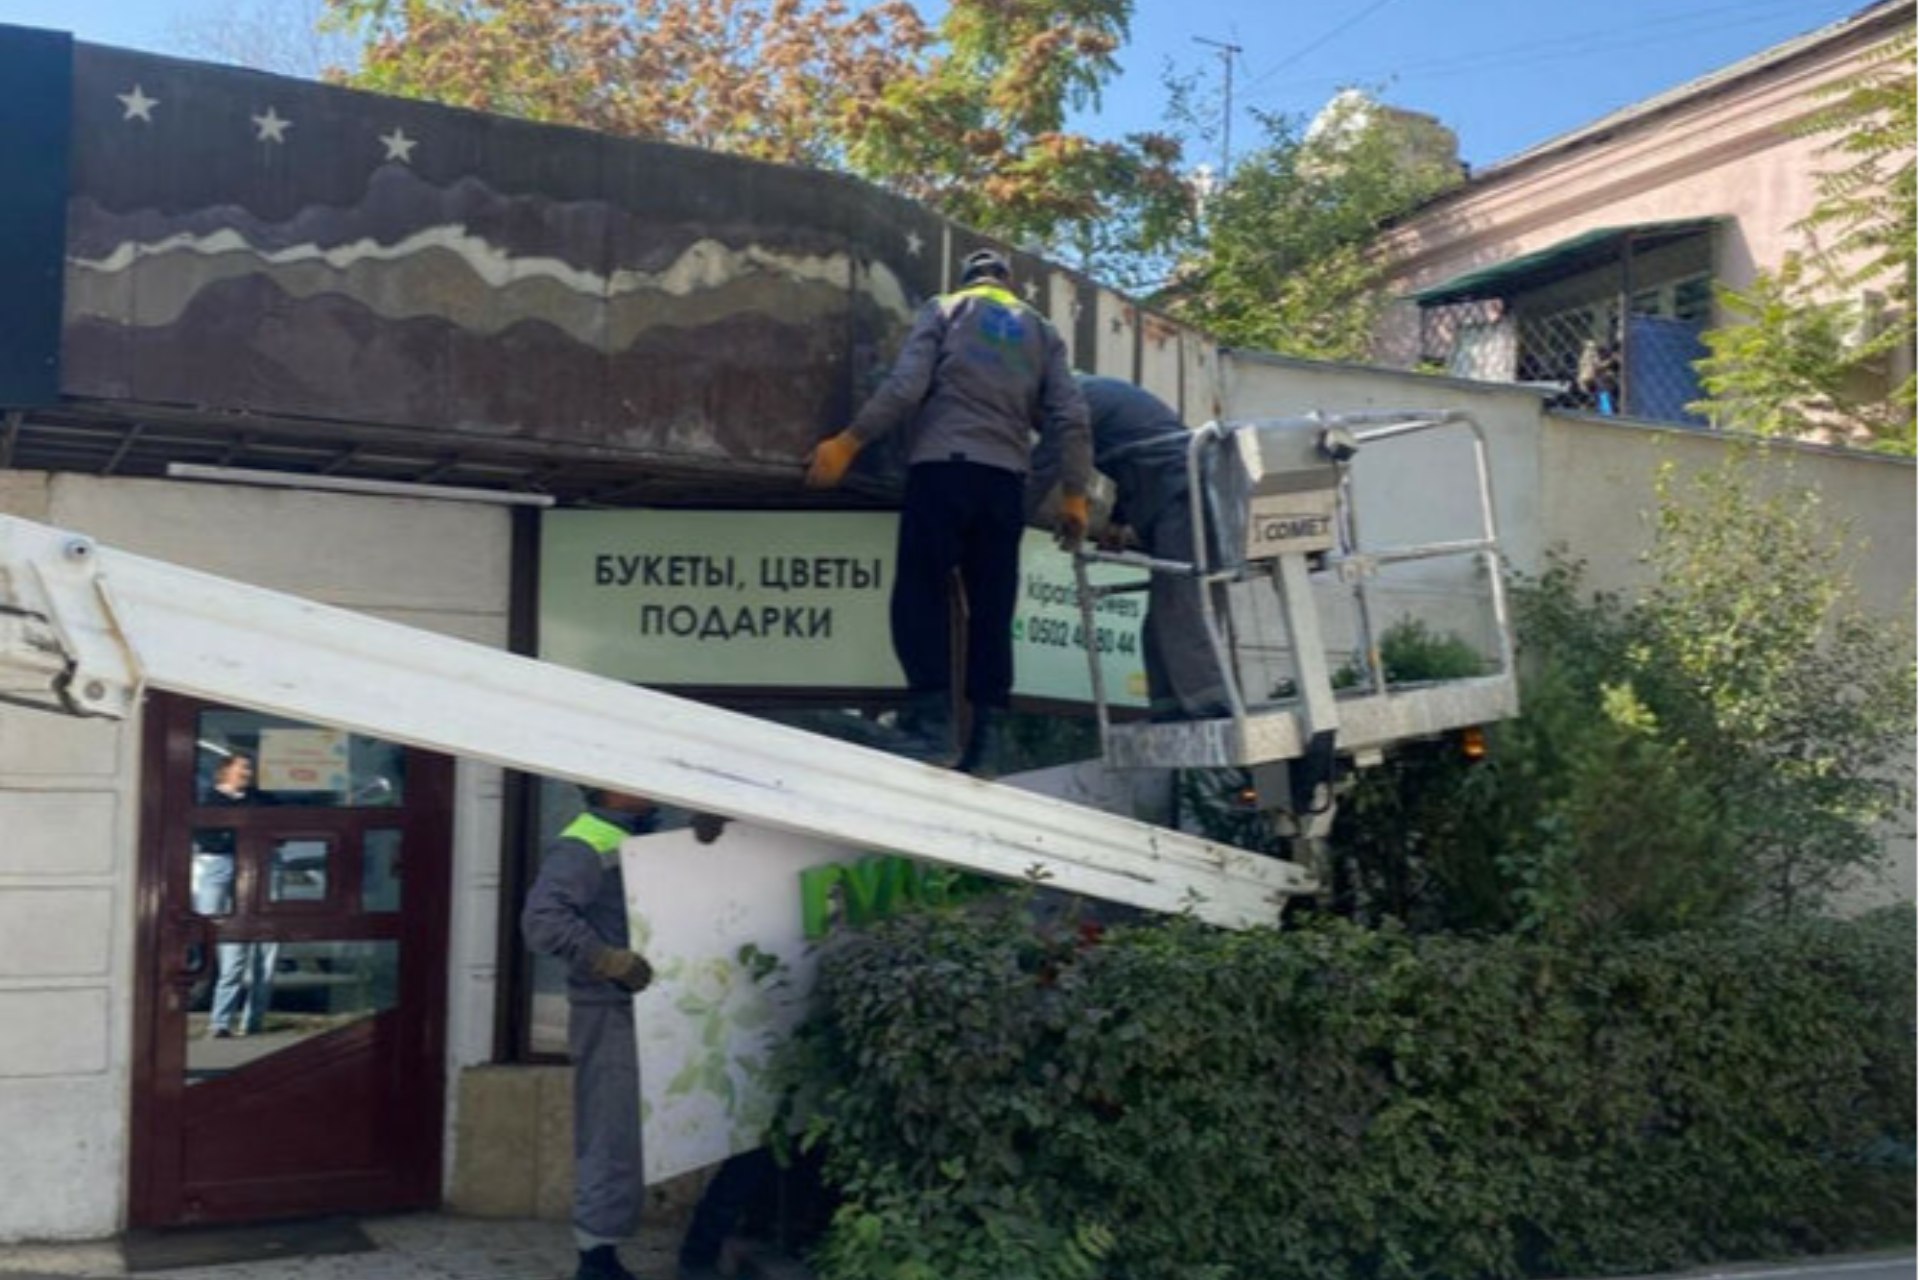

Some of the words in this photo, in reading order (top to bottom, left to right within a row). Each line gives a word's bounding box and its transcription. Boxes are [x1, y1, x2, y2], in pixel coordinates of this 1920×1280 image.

[1265, 516, 1331, 541] COMET
[595, 554, 746, 590] БУКЕТЫ,
[759, 557, 882, 591] ЦВЕТЫ
[640, 604, 833, 640] ПОДАРКИ
[1029, 616, 1068, 647] 0502
[1116, 631, 1136, 655] 44
